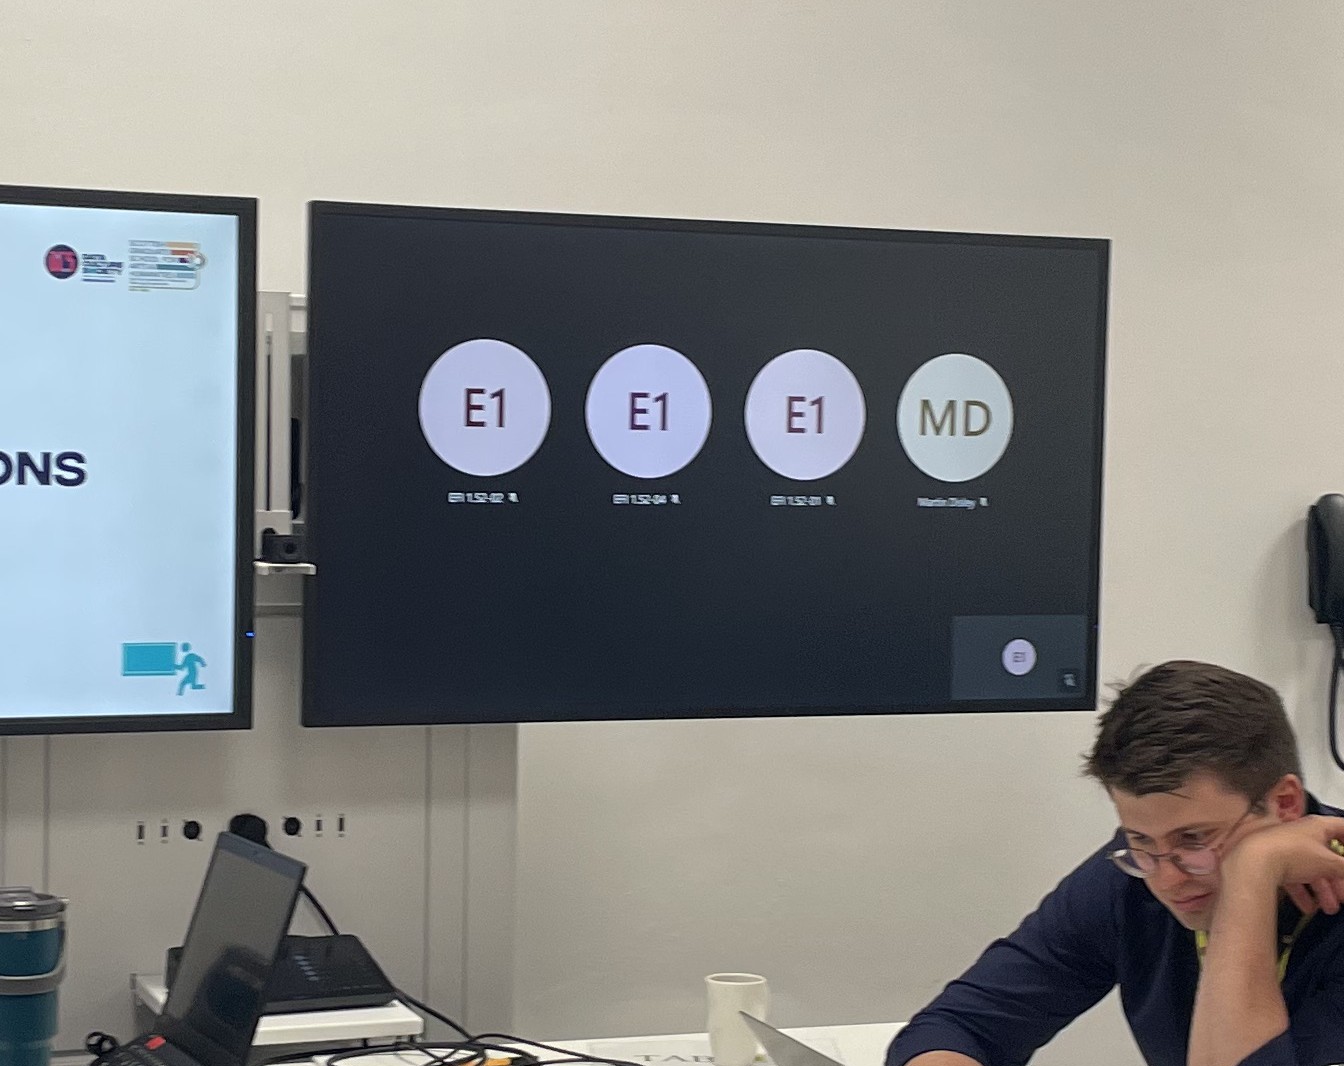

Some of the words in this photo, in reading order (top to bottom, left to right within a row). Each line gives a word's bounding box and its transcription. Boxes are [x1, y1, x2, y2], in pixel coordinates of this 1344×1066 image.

[464, 386, 508, 430] E1
[628, 391, 670, 433] E1
[786, 395, 825, 435] E1
[918, 398, 993, 438] MD
